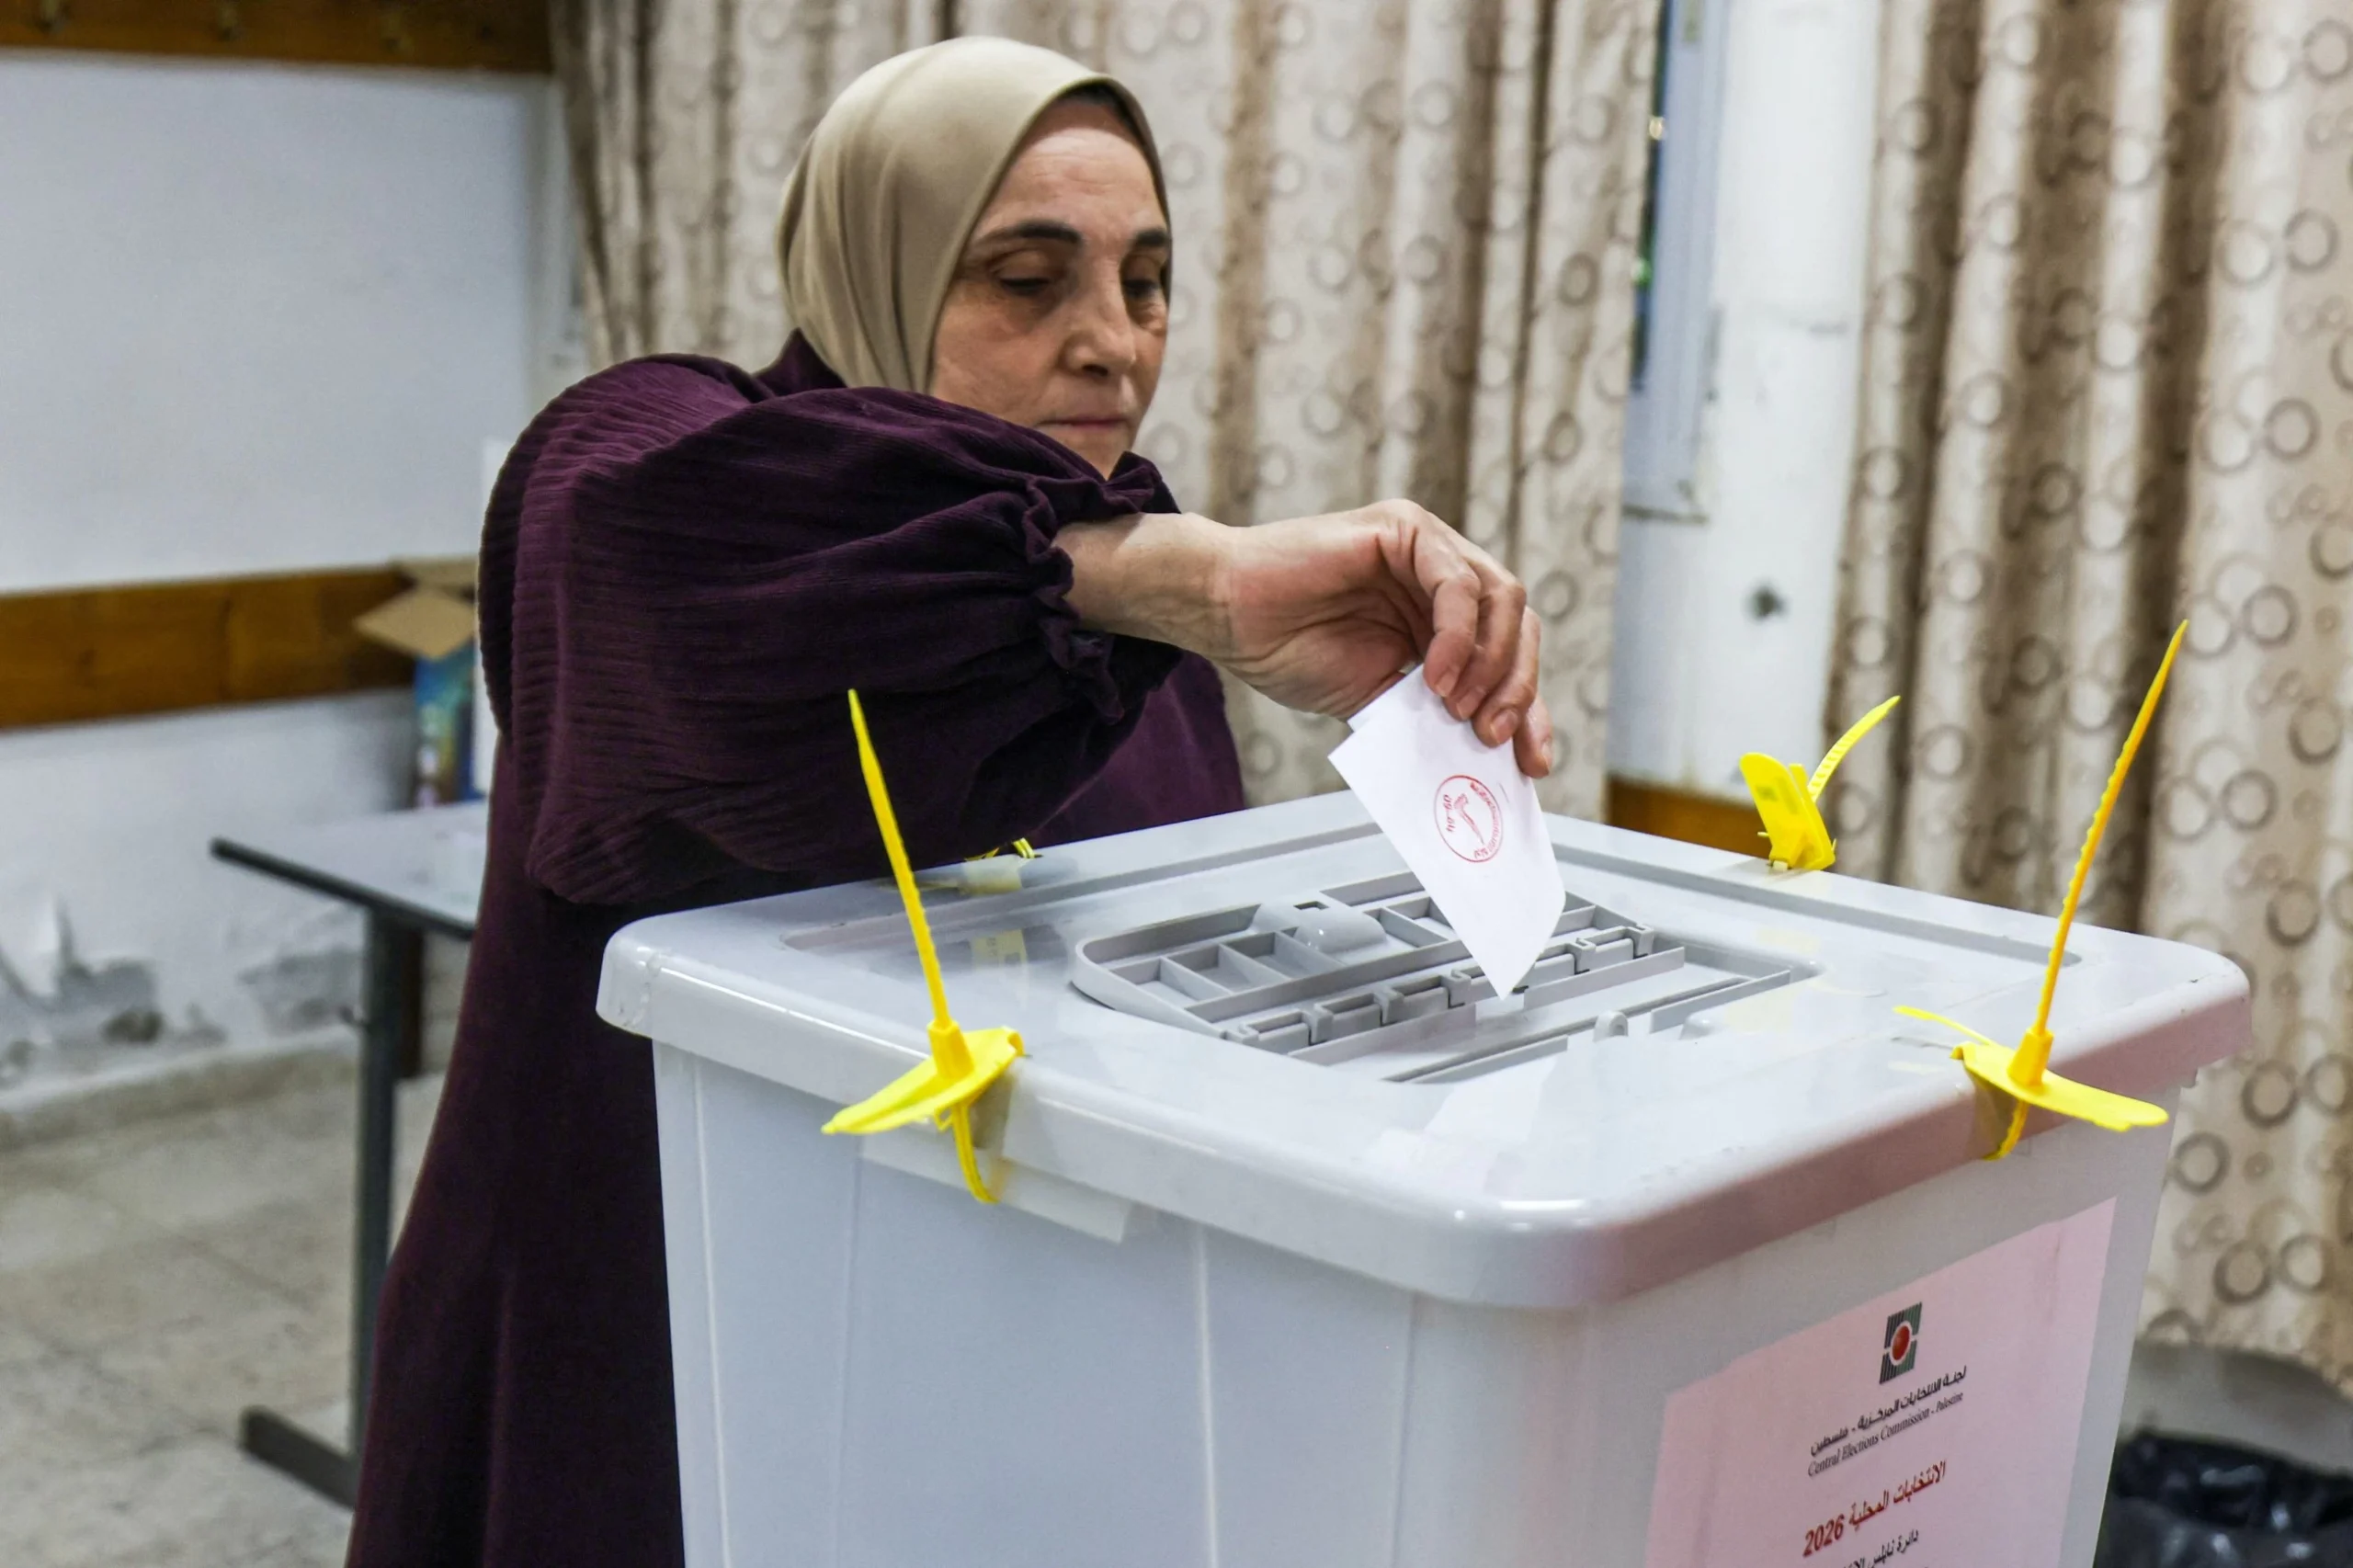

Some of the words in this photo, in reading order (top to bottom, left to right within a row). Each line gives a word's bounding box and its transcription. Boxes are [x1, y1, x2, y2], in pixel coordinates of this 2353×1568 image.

[1858, 1399, 1900, 1430] المركزية
[1900, 1378, 1942, 1409] الانتخابات
[1808, 1448, 1840, 1477] Central
[1841, 1433, 1880, 1460] Elections
[1881, 1406, 1930, 1441] Commission
[1936, 1392, 1964, 1414] Palestine
[1811, 1426, 1848, 1457] فلسطين
[1893, 1460, 1947, 1504] الانتخابات
[1848, 1489, 1891, 1531] المحلية
[1802, 1514, 1846, 1558] 2026
